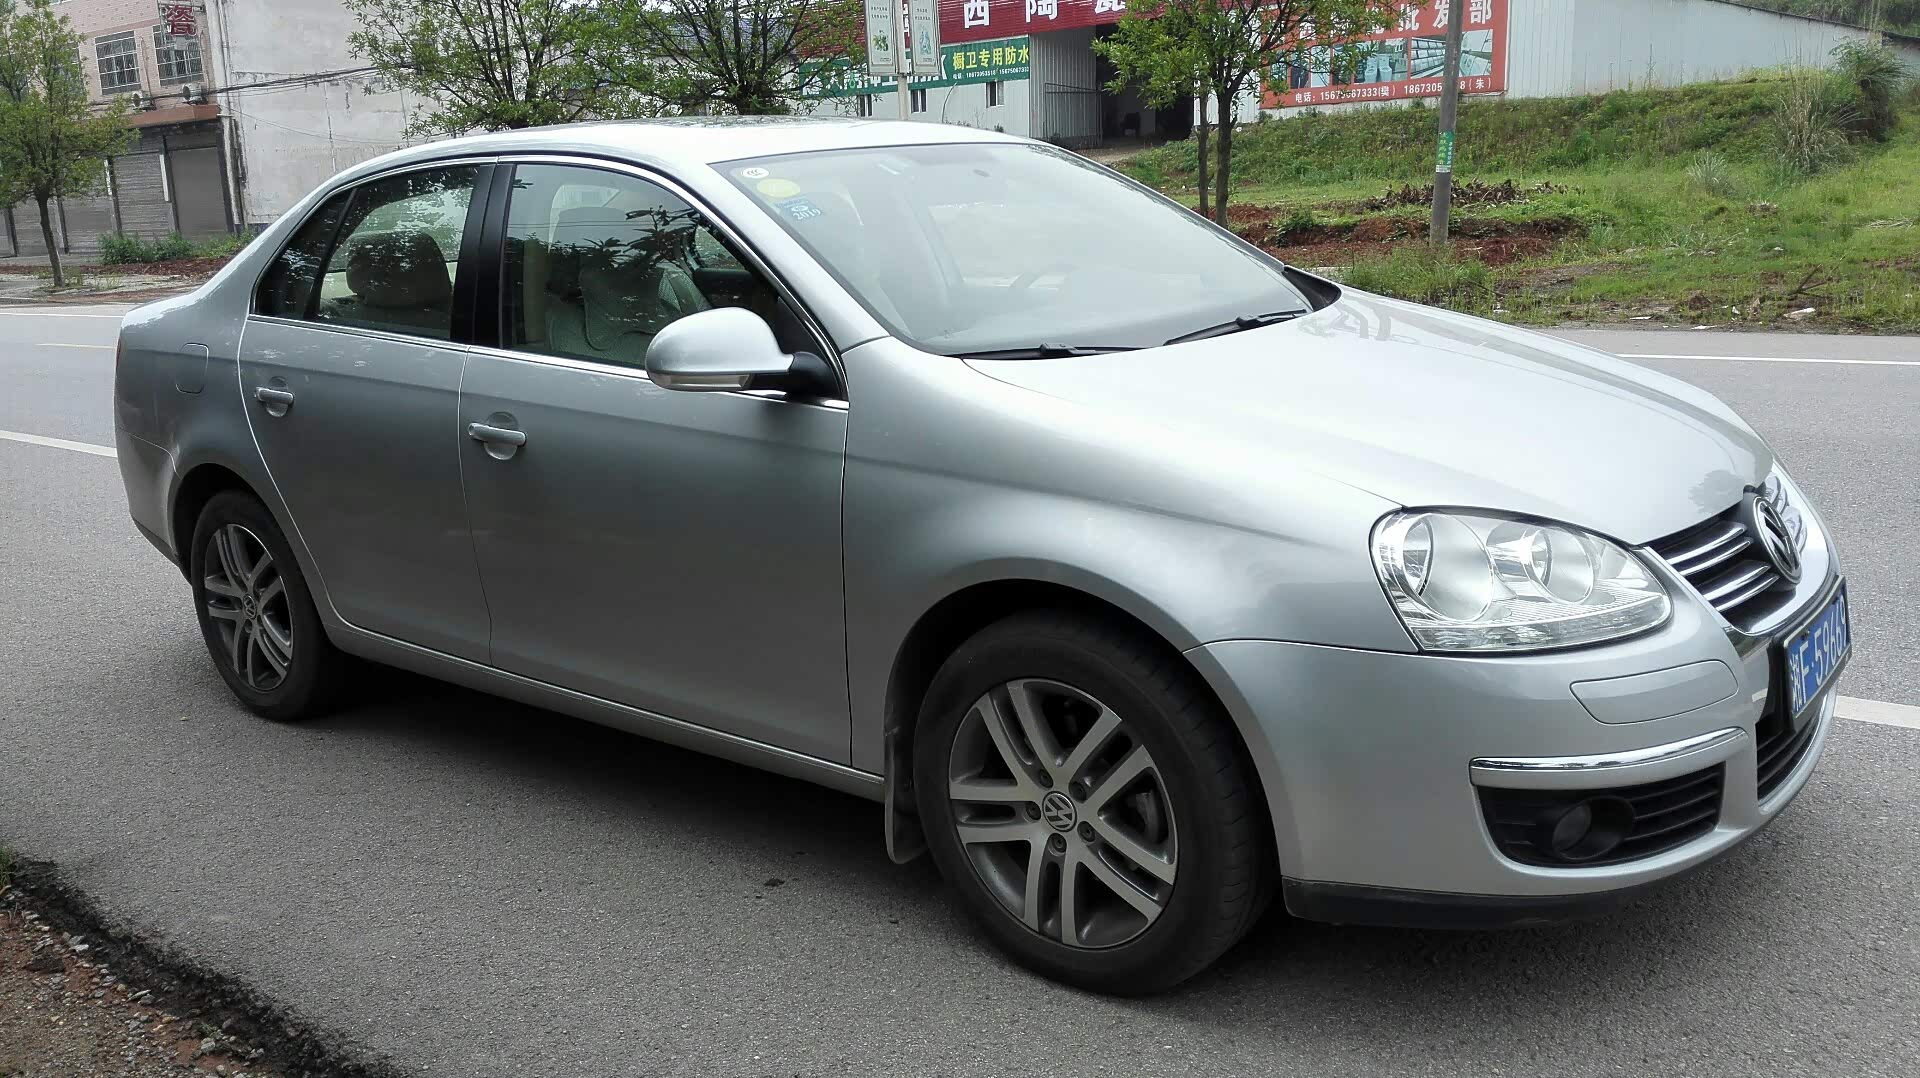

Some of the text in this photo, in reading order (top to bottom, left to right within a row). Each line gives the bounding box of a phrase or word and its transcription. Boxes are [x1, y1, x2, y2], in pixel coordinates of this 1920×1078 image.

[953, 44, 1029, 70] 橱卫专用防水
